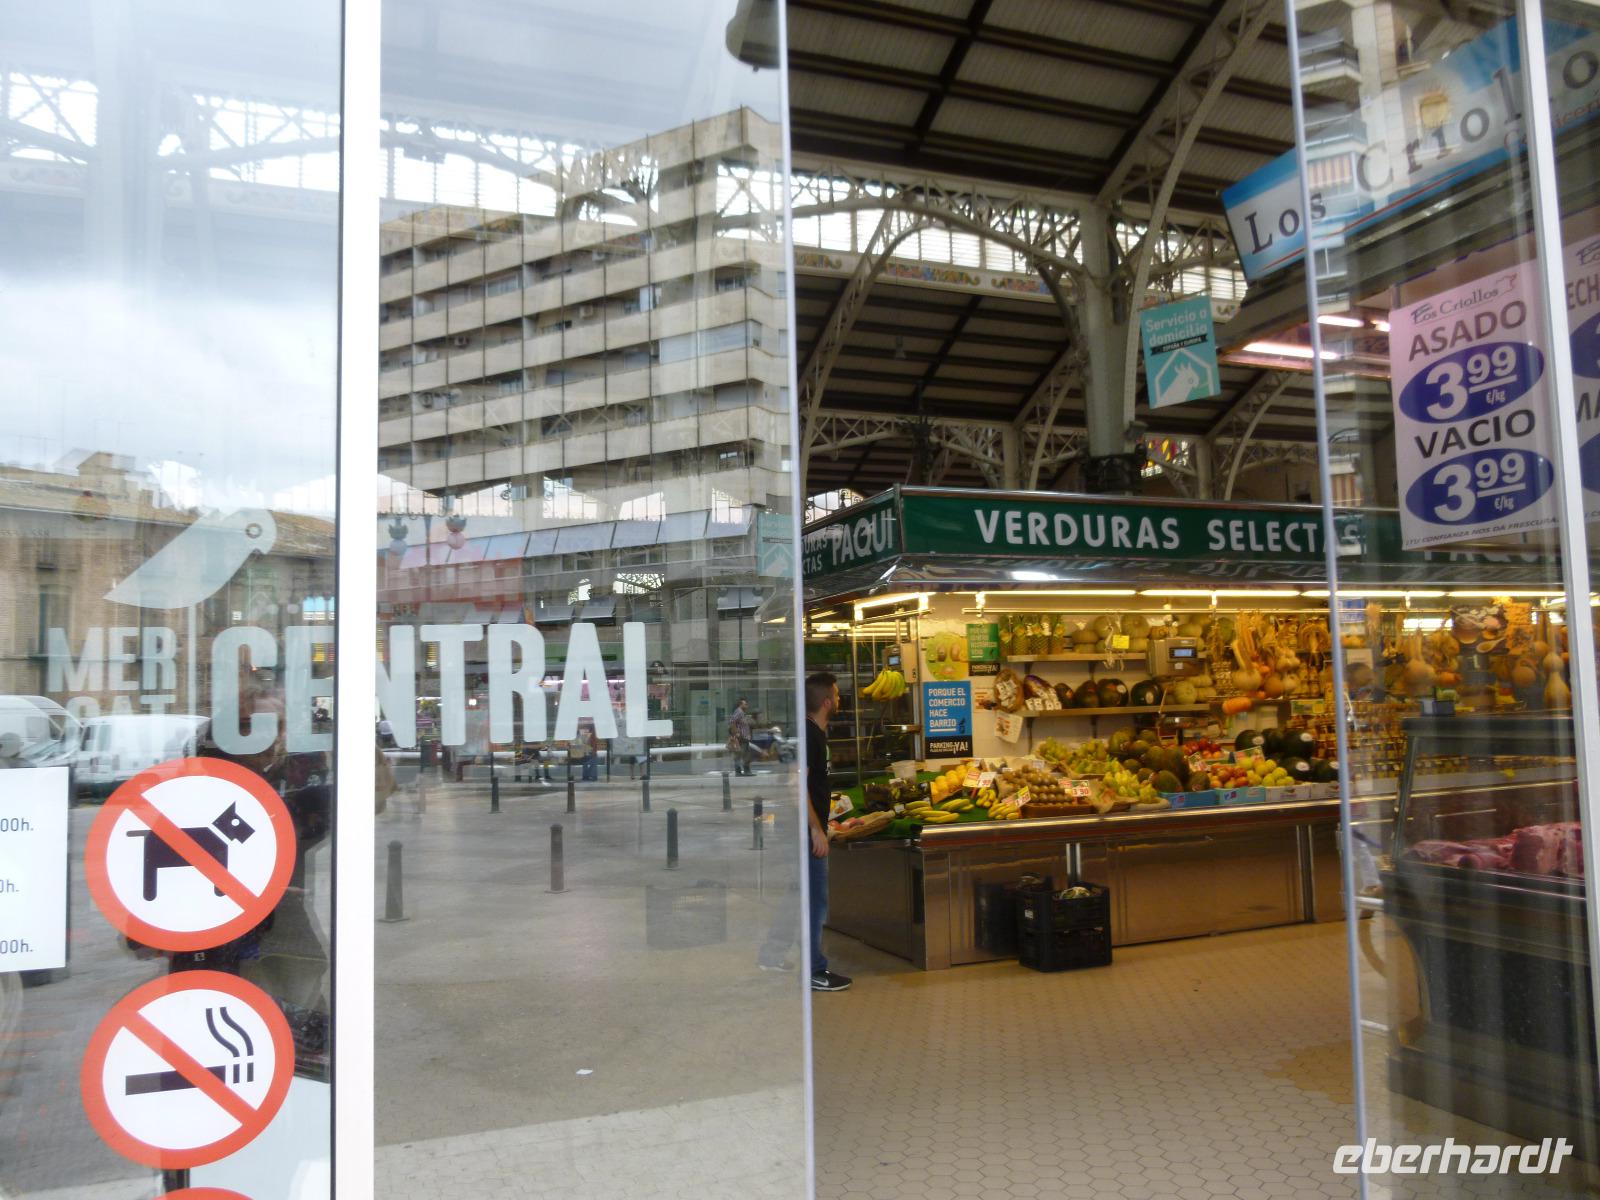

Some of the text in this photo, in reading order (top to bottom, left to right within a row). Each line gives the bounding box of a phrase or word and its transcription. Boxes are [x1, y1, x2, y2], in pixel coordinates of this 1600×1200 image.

[1244, 51, 1599, 255] Los Criolo
[1440, 289, 1499, 315] Criollos
[1145, 311, 1196, 333] Servicio
[1149, 323, 1208, 346] domicilio
[1409, 301, 1527, 361] ASADO
[1414, 409, 1536, 459] VACIO
[831, 507, 893, 566] PAQUI
[974, 509, 1361, 554] VERDURAS SELECTS
[48, 622, 673, 754] MER CENTRAL
[928, 687, 966, 697] PORQUE EL
[928, 698, 966, 707] COMERCIO
[929, 708, 948, 717] HACE
[929, 718, 957, 728] BARRIO
